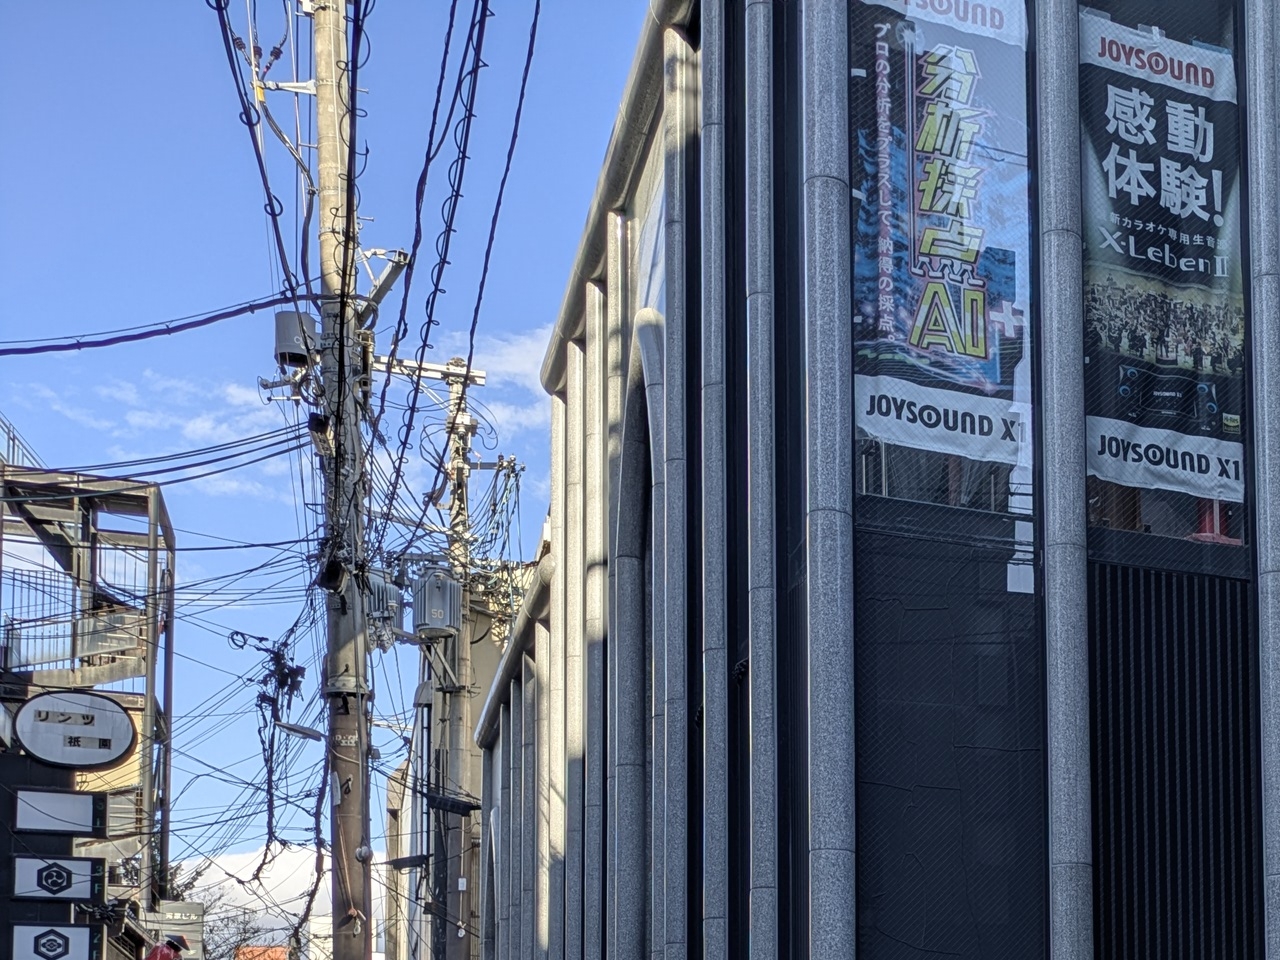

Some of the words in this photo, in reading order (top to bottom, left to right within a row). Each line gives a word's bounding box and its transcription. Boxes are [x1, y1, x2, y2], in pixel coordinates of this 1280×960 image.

[1098, 36, 1215, 89] JOYSOUND
[1105, 84, 1214, 163] 感動
[874, 23, 896, 342] プロの分析をプラスして、納得の採点。
[1101, 142, 1224, 227] 体験!
[866, 394, 993, 437] JOYSOUND
[1000, 418, 1026, 443] X1
[1098, 434, 1211, 475] JOYSOUND
[1217, 457, 1240, 480] X1
[431, 608, 444, 619] 50
[37, 710, 94, 725] リンツ
